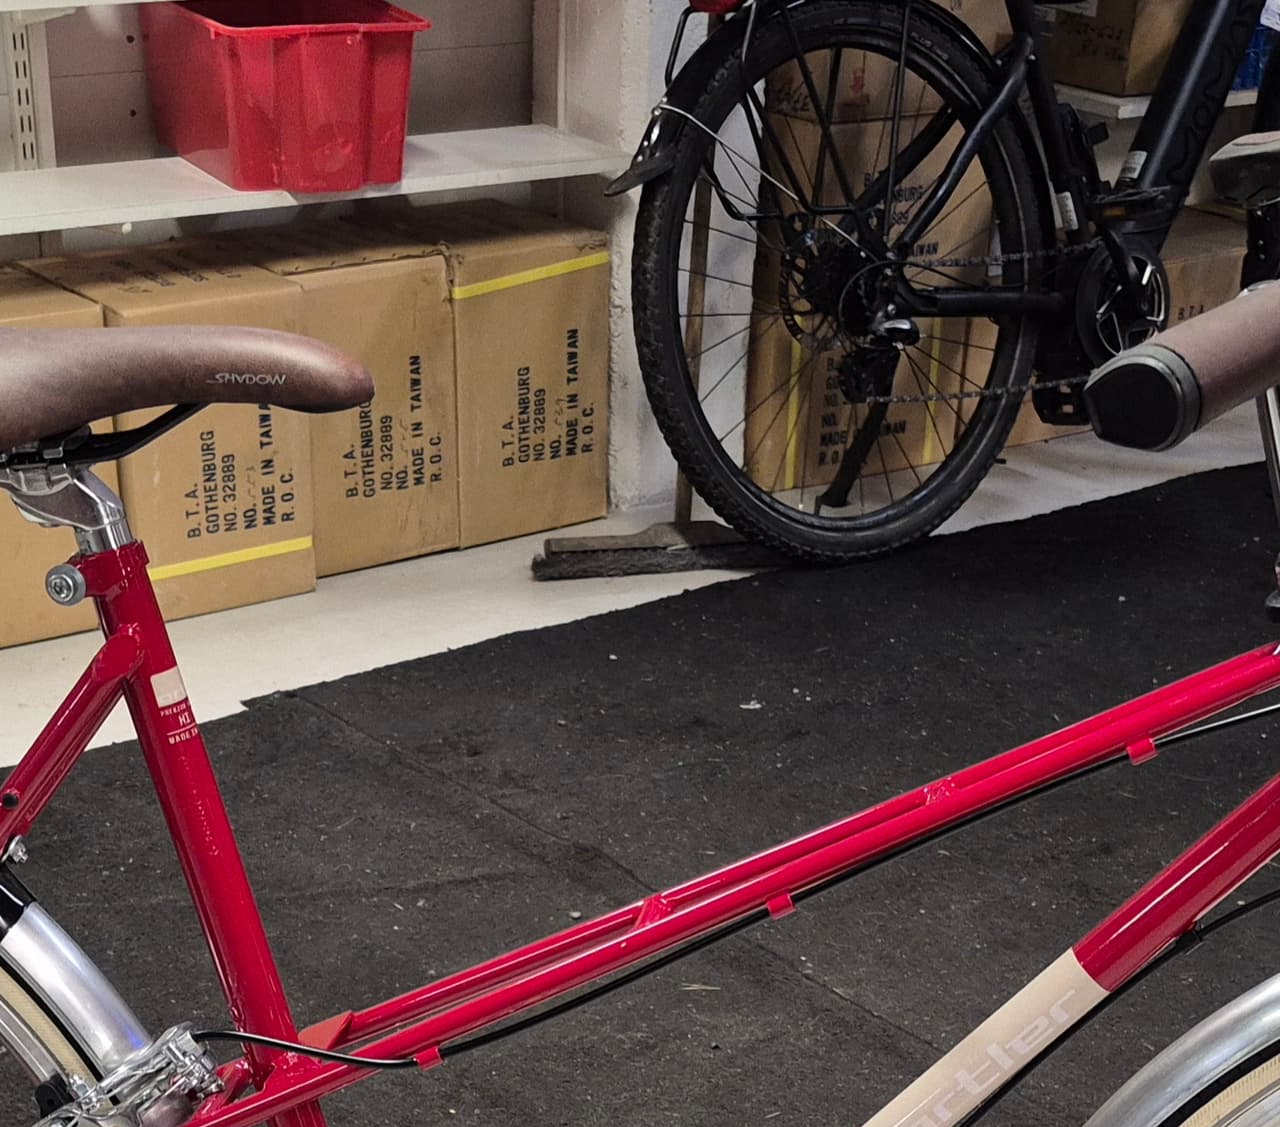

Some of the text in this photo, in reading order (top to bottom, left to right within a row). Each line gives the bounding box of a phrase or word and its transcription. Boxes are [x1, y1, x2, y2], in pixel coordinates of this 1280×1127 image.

[409, 355, 424, 486] MADE IN TAIWAN
[517, 366, 530, 463] GOTHENBURG
[533, 388, 546, 461] NO. 32889
[566, 328, 579, 456] MADE IN TAIWAN
[200, 430, 220, 534] GOTHENBURG
[260, 458, 275, 476] IN
[380, 415, 394, 491] NO. 32889
[395, 465, 409, 491] NO.
[549, 434, 562, 460] NO.
[221, 454, 238, 532] NO. 32889
[243, 503, 257, 530] NO.
[261, 485, 276, 526] MADE
[168, 730, 191, 745] MADE
